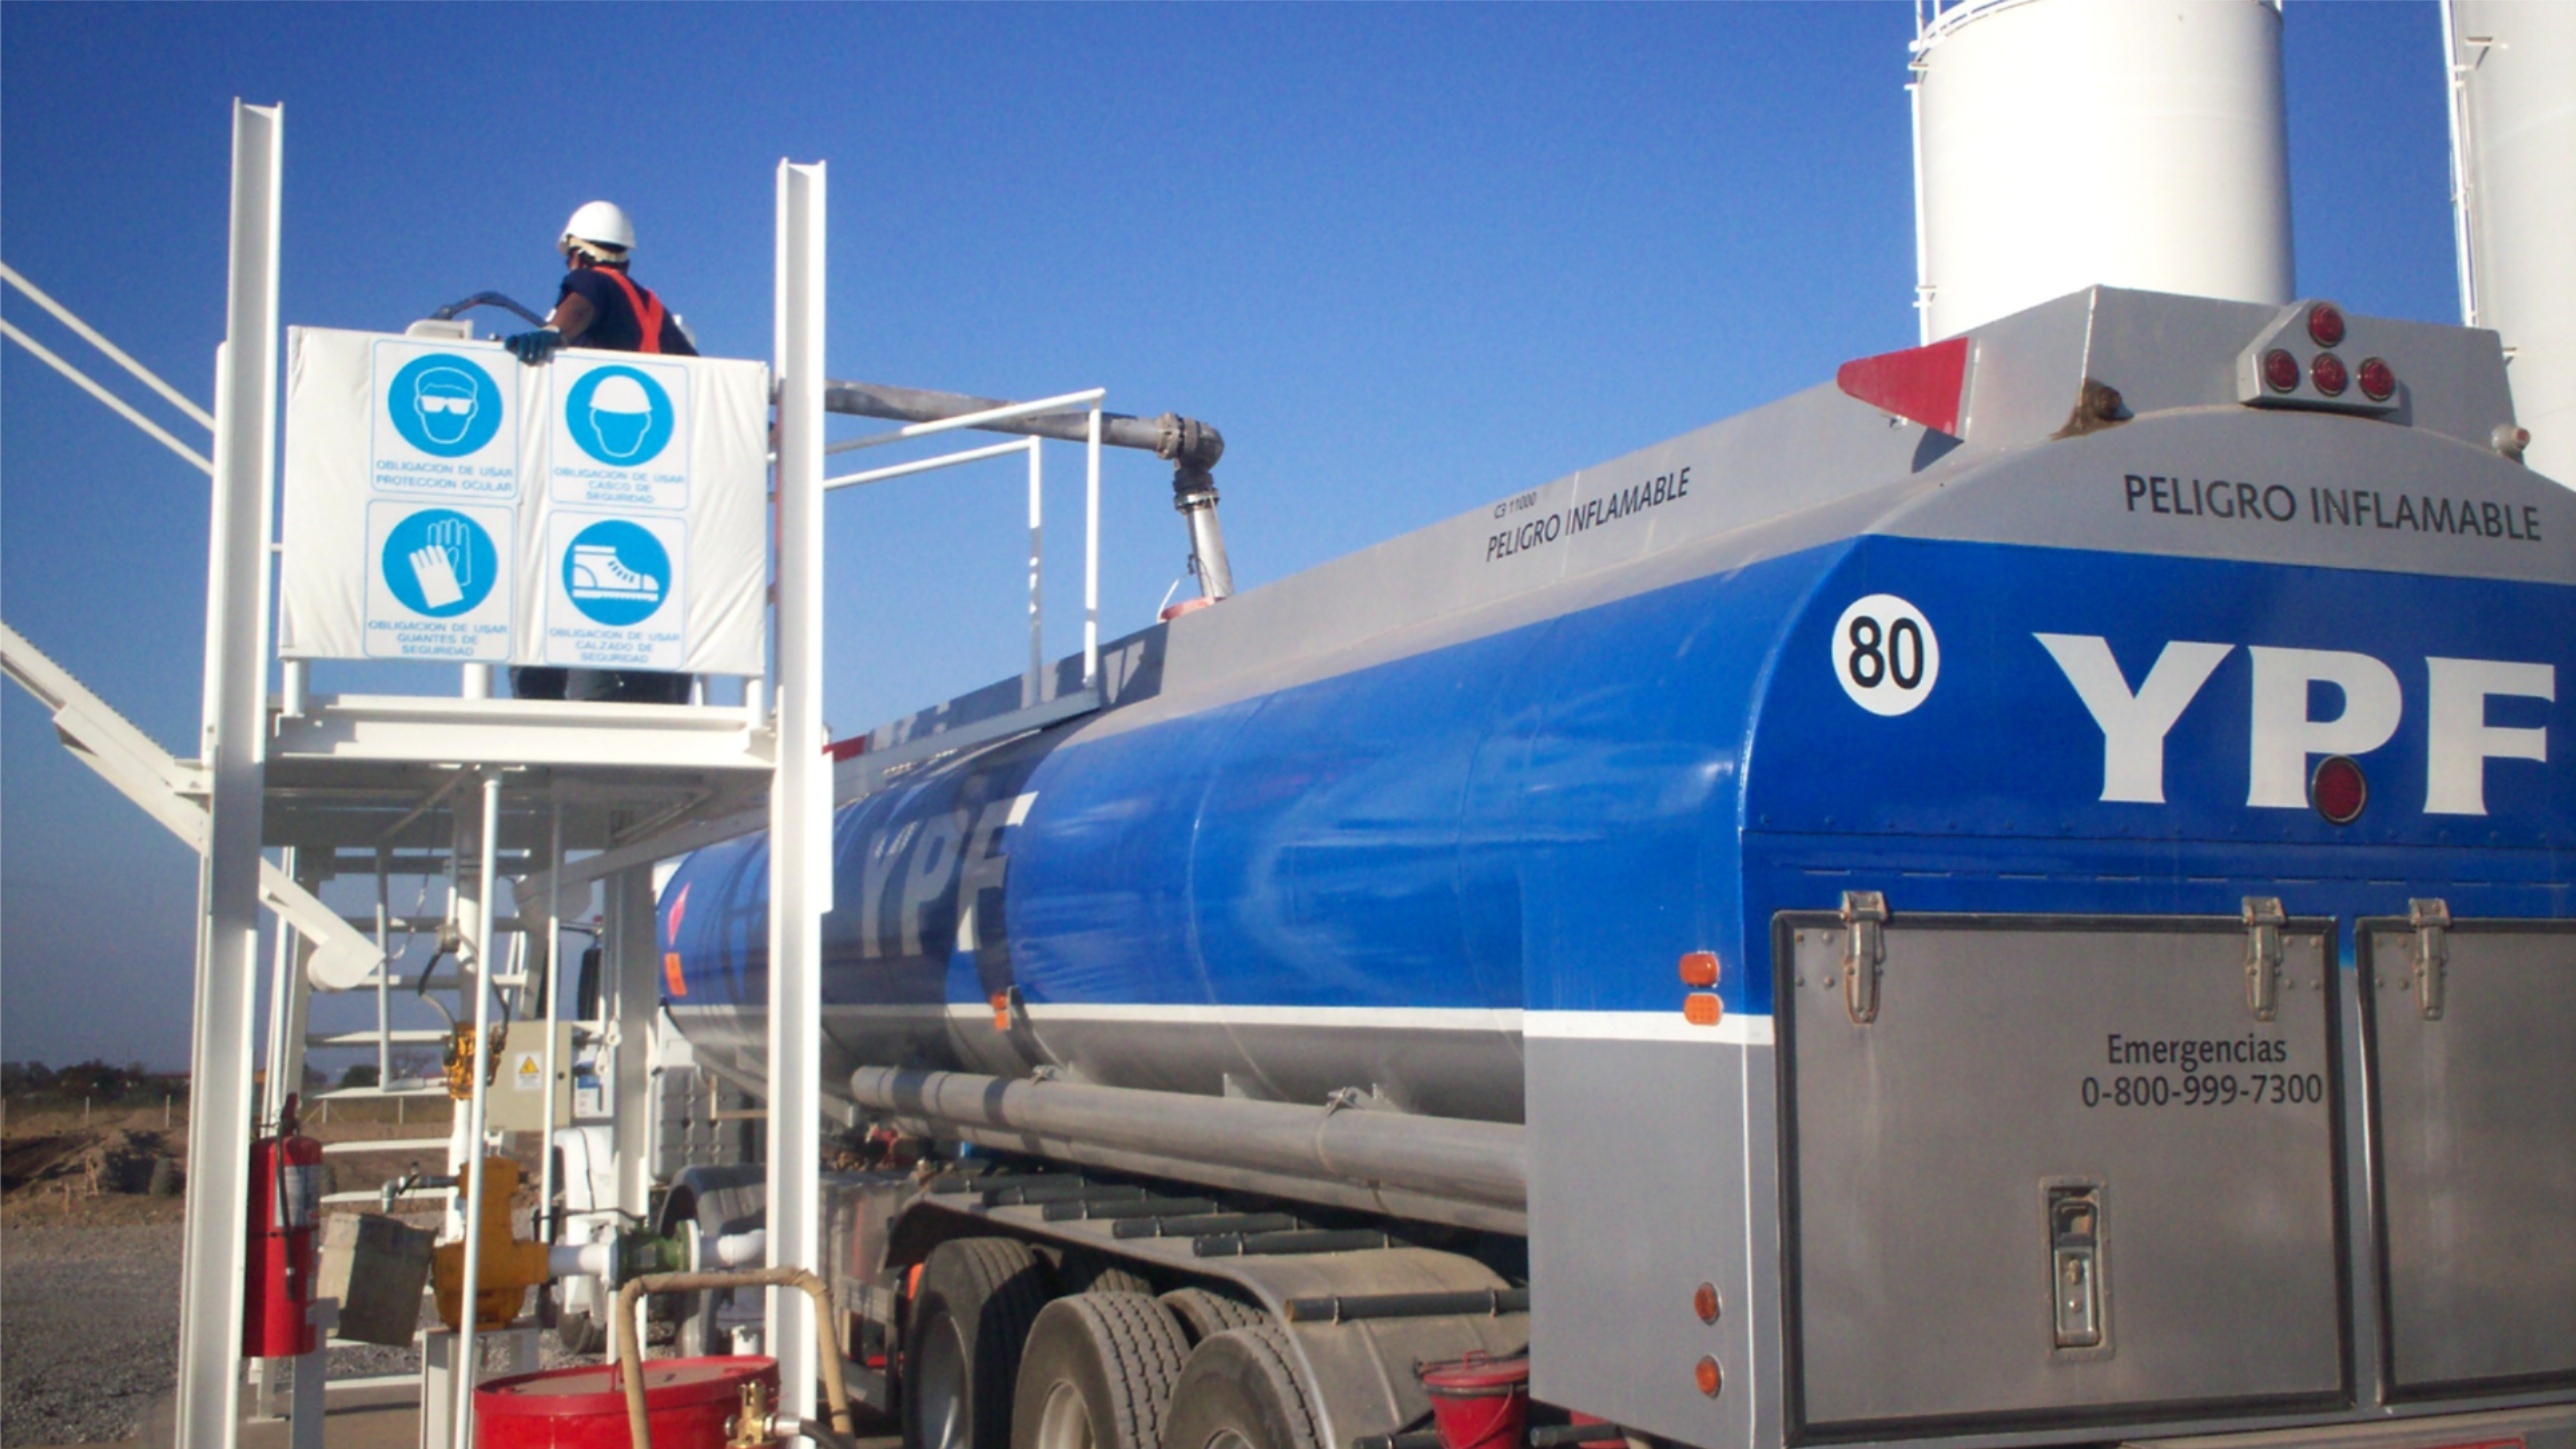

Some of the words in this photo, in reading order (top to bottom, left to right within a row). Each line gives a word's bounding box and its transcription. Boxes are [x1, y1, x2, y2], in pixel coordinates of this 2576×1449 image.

[376, 460, 453, 473] OBLIGACION
[458, 465, 474, 475] DE
[480, 467, 513, 477] USAR
[376, 475, 457, 488] PROTECCION
[461, 480, 513, 491] OCULAR
[632, 472, 648, 481] DE
[653, 474, 685, 483] USAR
[588, 480, 631, 491] CASCO
[635, 484, 650, 492] DE
[1486, 513, 1561, 563] PELIGRO
[1565, 466, 1691, 536] INFLAMABLE
[2124, 474, 2297, 522] PELIGRO
[2310, 487, 2542, 541] INFLAMABLE
[368, 620, 446, 632] OBLIGACION
[451, 623, 467, 632] DE
[474, 624, 507, 634] USAR
[397, 633, 456, 644] GUANTES
[462, 635, 478, 645] DE
[627, 631, 642, 640] DE
[401, 644, 474, 656] SEGURIDAD
[575, 640, 633, 651] CALZADO
[637, 643, 653, 652] DE
[1848, 614, 1924, 690] 80
[2032, 632, 2556, 816] YPF
[861, 791, 1039, 958] YPF
[2107, 1033, 2288, 1072] Emergencias
[2081, 1073, 2323, 1108] 0-800-999-7300
